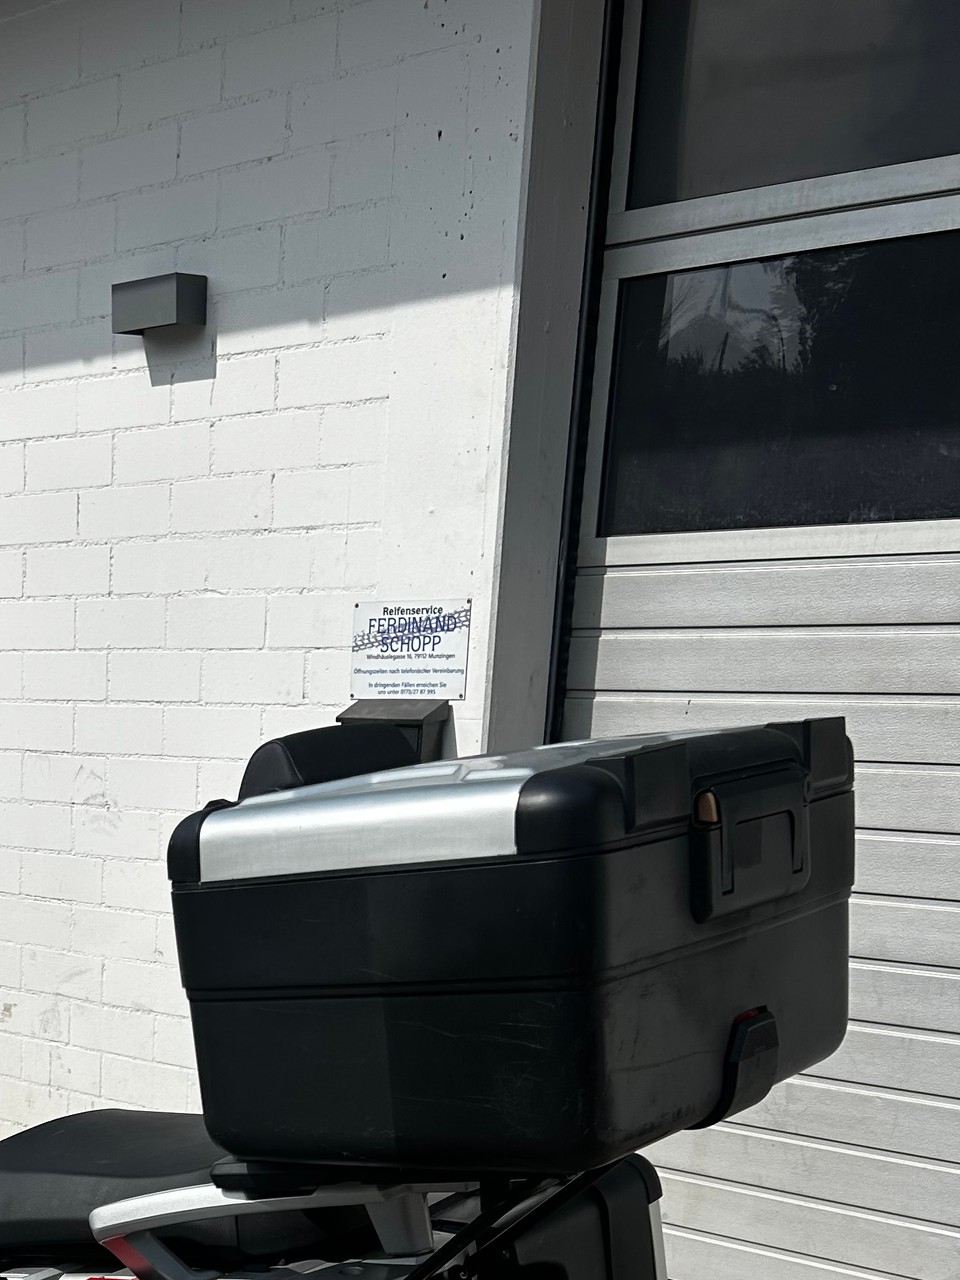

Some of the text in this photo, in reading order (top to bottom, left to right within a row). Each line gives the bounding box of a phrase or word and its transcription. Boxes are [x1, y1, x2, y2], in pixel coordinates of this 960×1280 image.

[383, 606, 443, 616] Reifenservice
[368, 616, 457, 634] FERDINAND
[380, 635, 441, 653] SCHOPP
[374, 682, 400, 690] dringenden
